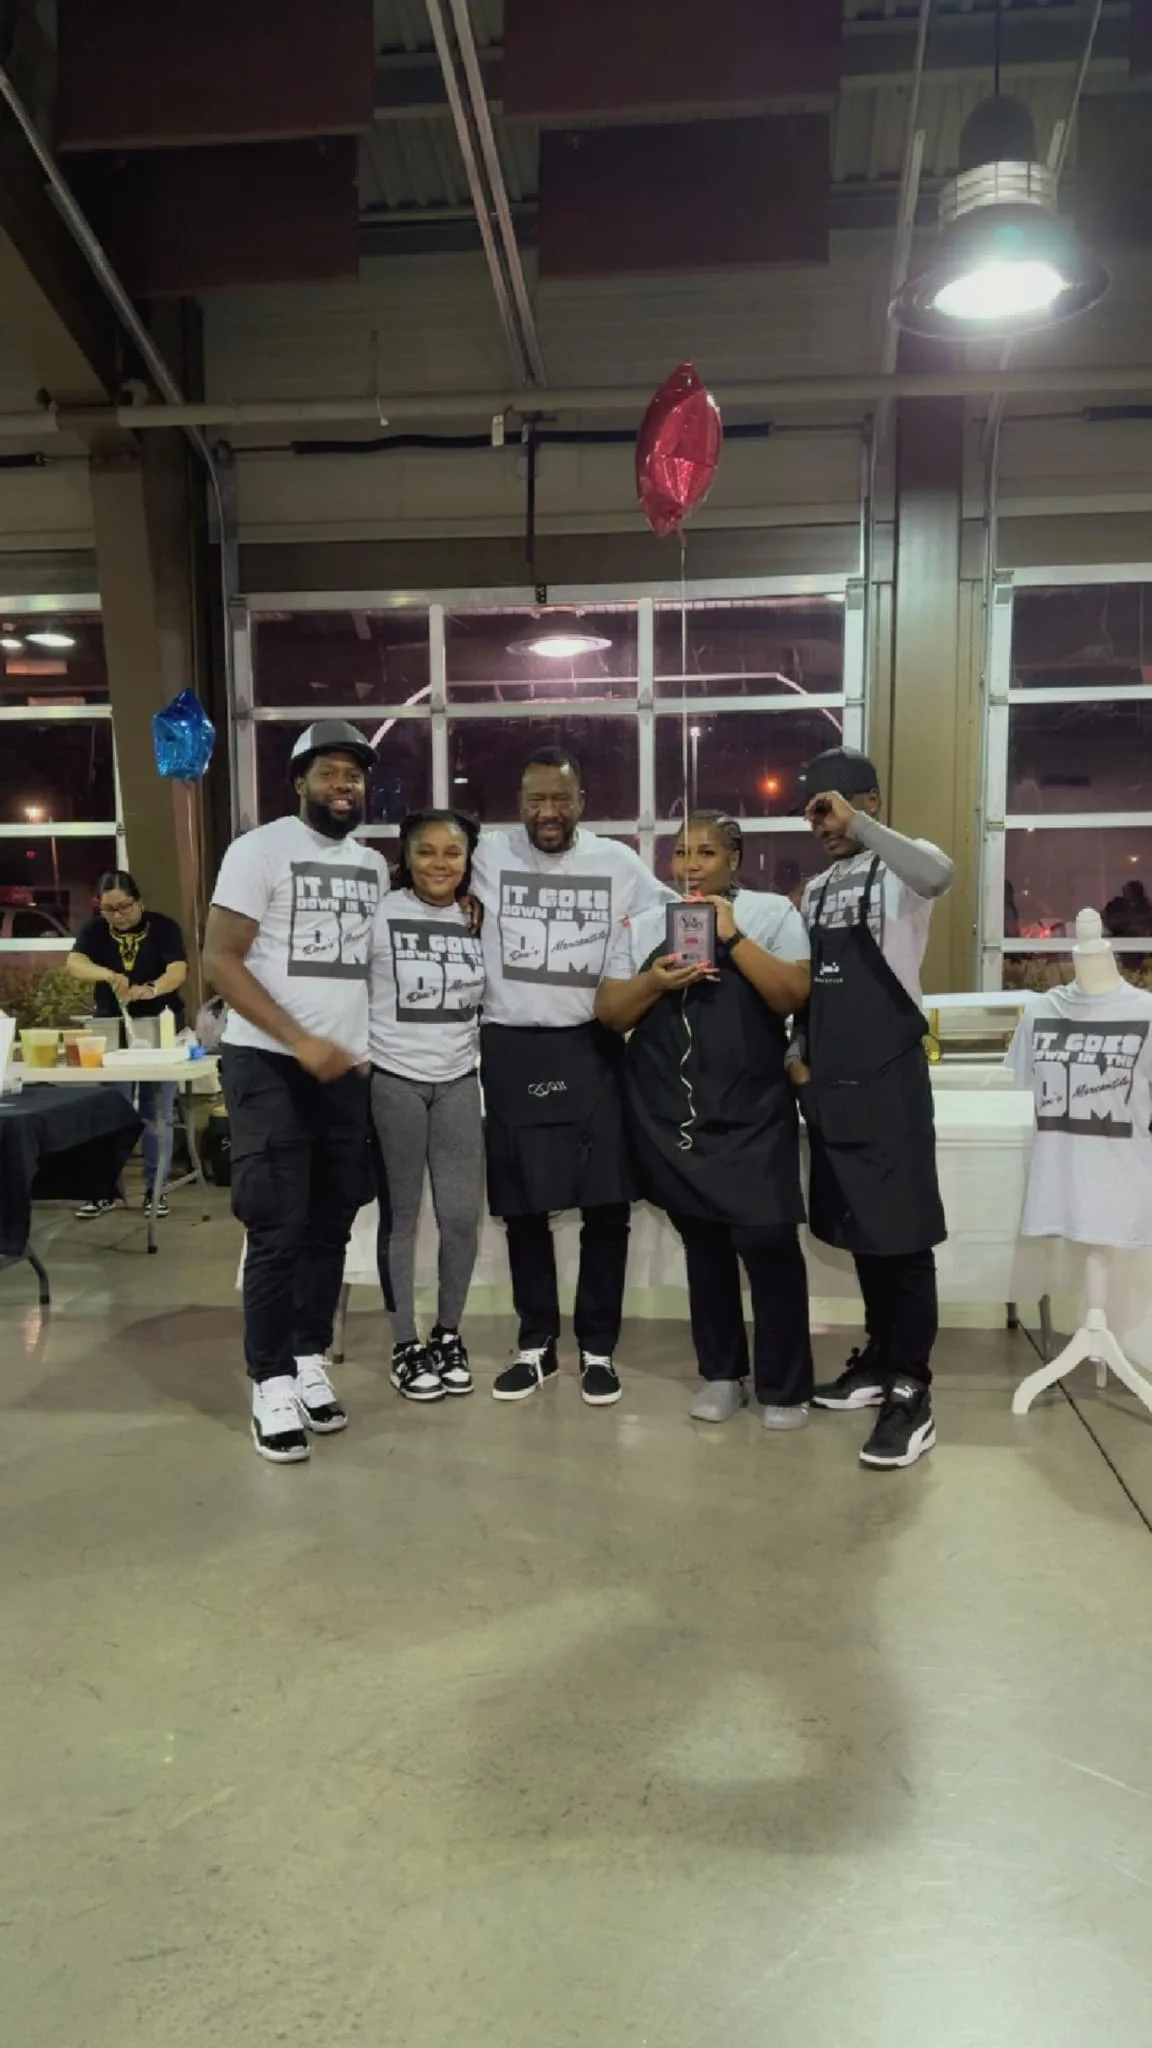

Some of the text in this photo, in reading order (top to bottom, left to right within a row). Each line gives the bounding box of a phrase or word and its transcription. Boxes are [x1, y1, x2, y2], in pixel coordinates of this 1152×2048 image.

[295, 876, 321, 897] IT
[503, 885, 609, 910] IT GOES
[502, 904, 548, 919] DOWN
[581, 909, 609, 922] THE
[393, 931, 419, 951] IT
[1032, 1032, 1058, 1050] IT
